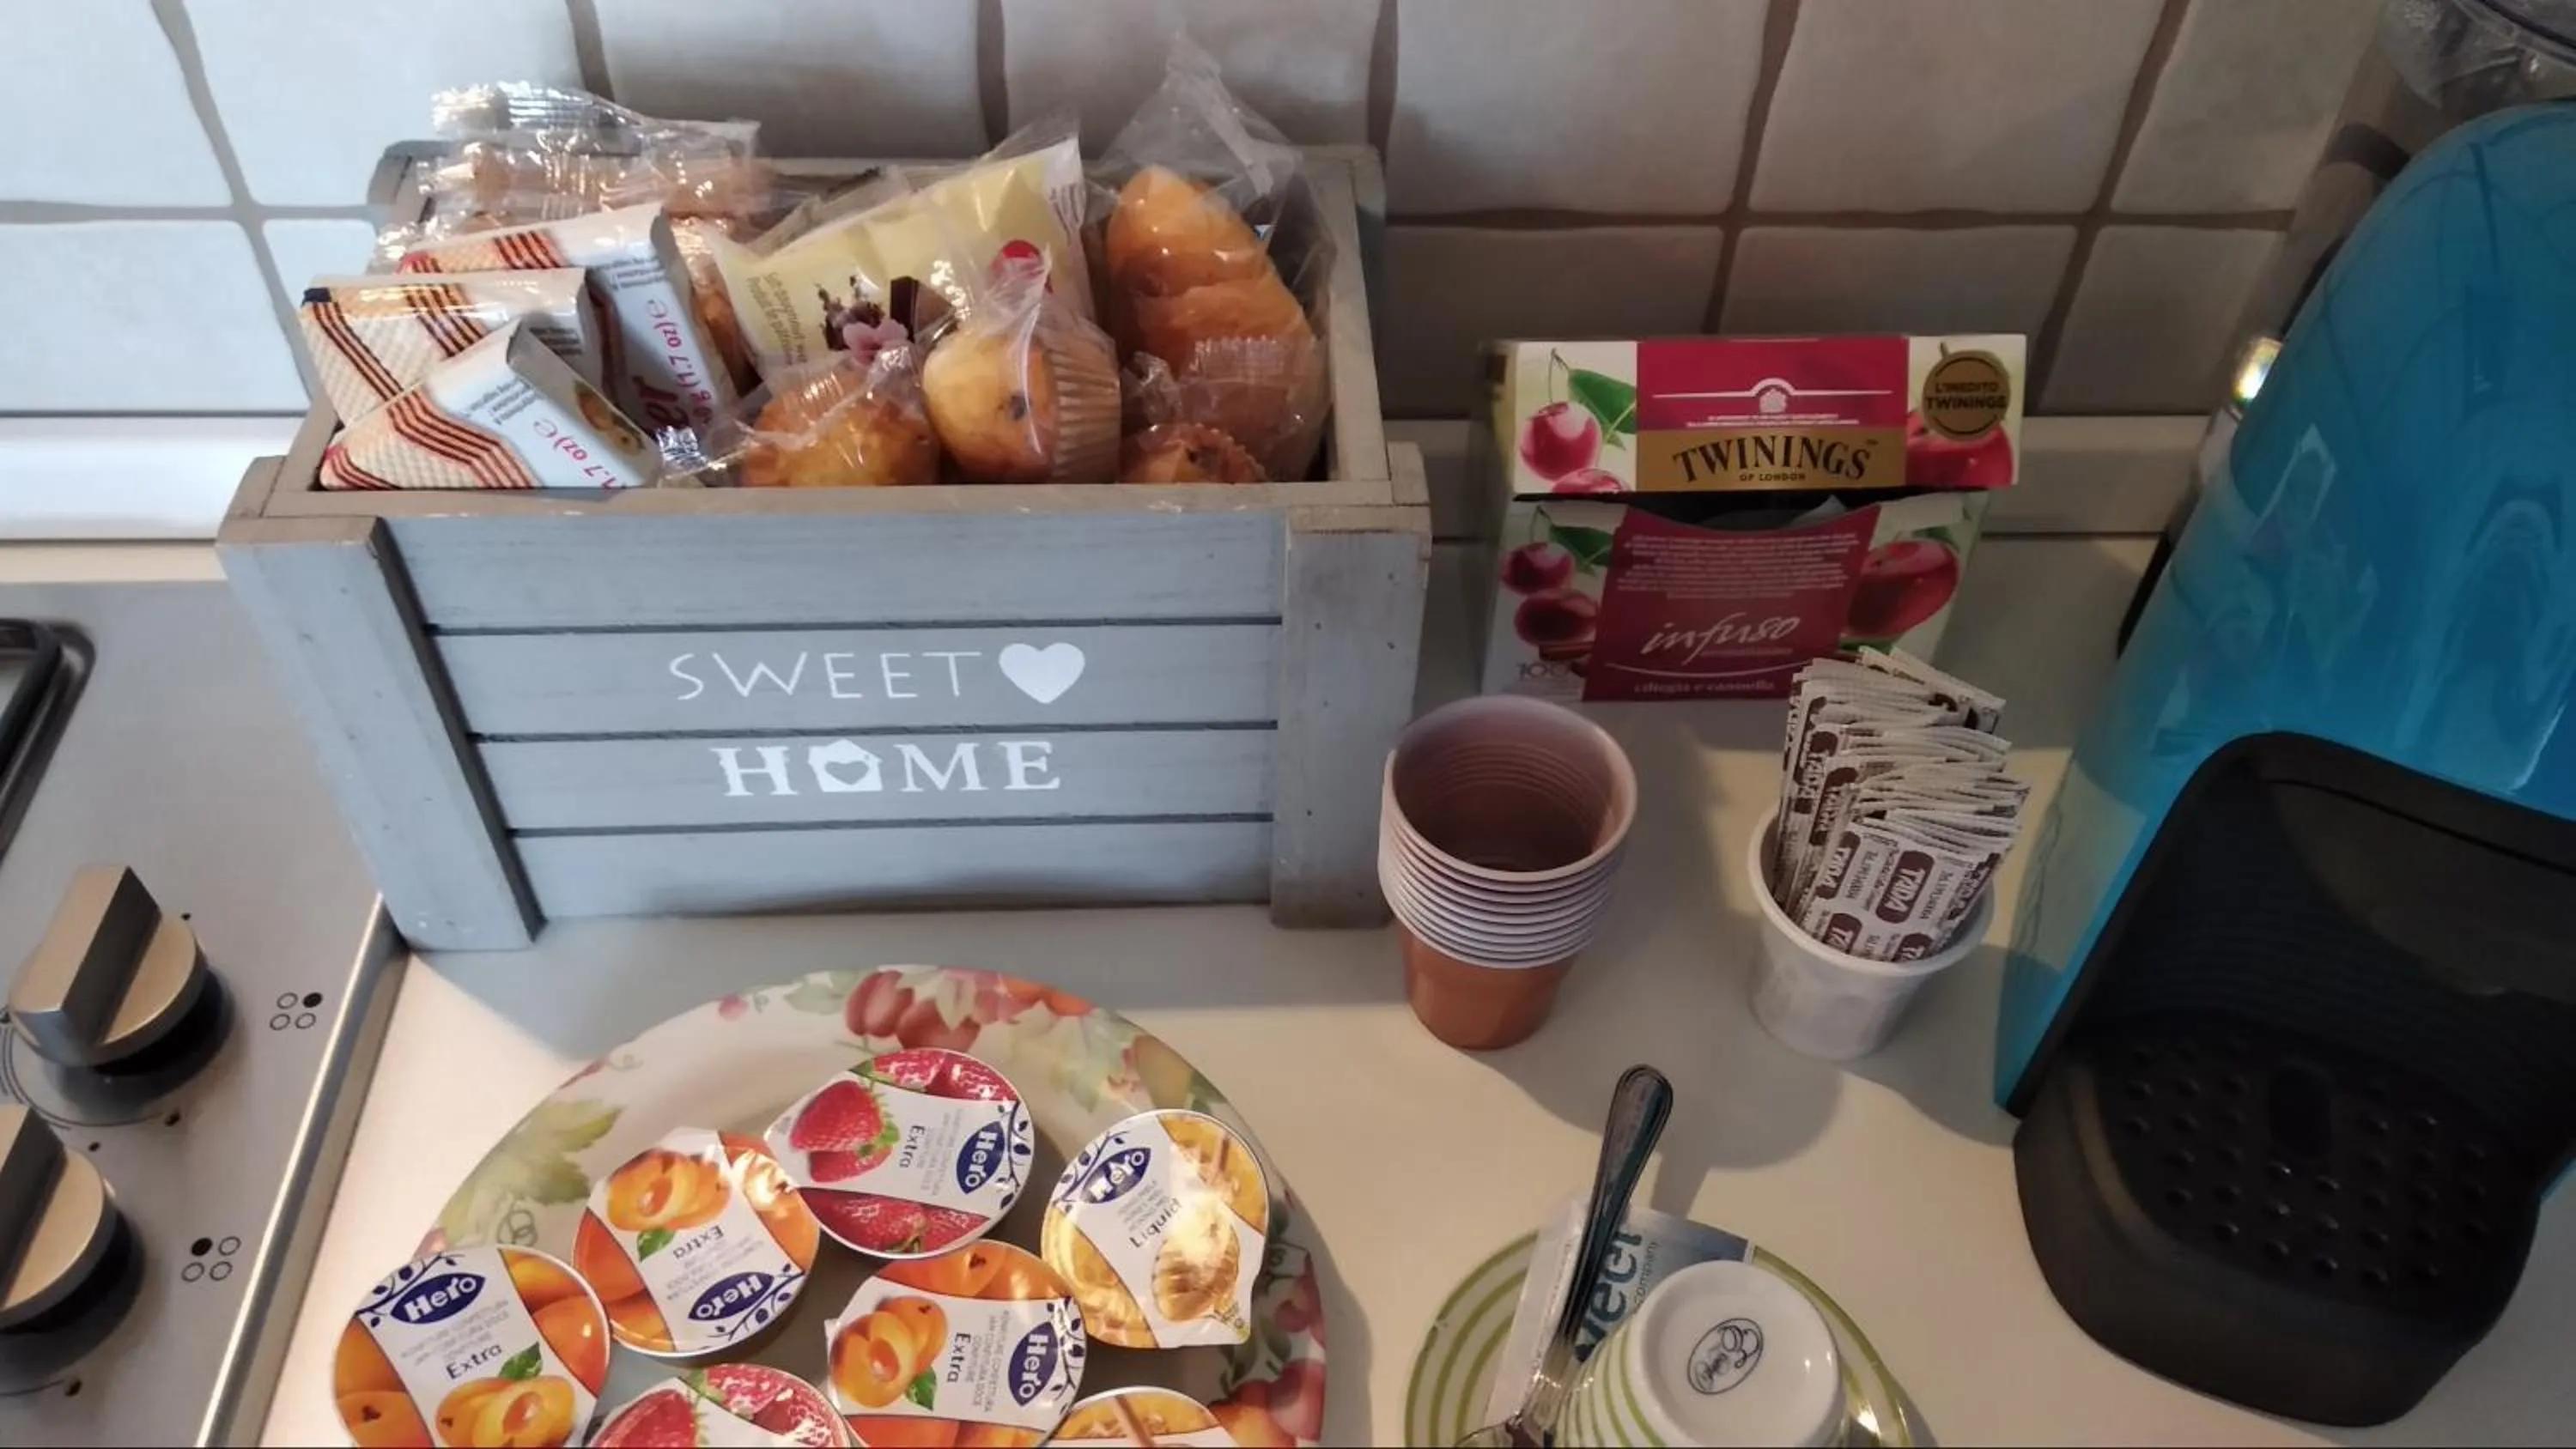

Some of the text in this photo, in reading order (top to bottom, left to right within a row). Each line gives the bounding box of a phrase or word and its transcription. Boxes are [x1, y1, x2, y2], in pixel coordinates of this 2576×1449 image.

[1925, 395, 2008, 410] TWININGS
[1672, 434, 1871, 483] TWININGS
[1739, 472, 1806, 483] OF LONDON
[1640, 611, 1801, 666] infuso
[668, 651, 982, 700] SWEET
[898, 1125, 926, 1168] Extra
[964, 1131, 998, 1187] Hero
[1089, 1150, 1145, 1202] Hero
[672, 1225, 724, 1259] Extra
[1128, 1197, 1182, 1249] Liquid
[403, 1276, 477, 1322] Hero
[696, 1274, 763, 1318] Hero
[446, 1343, 502, 1379] Extra
[946, 1332, 972, 1384] Extra
[1018, 1333, 1049, 1399] Hero
